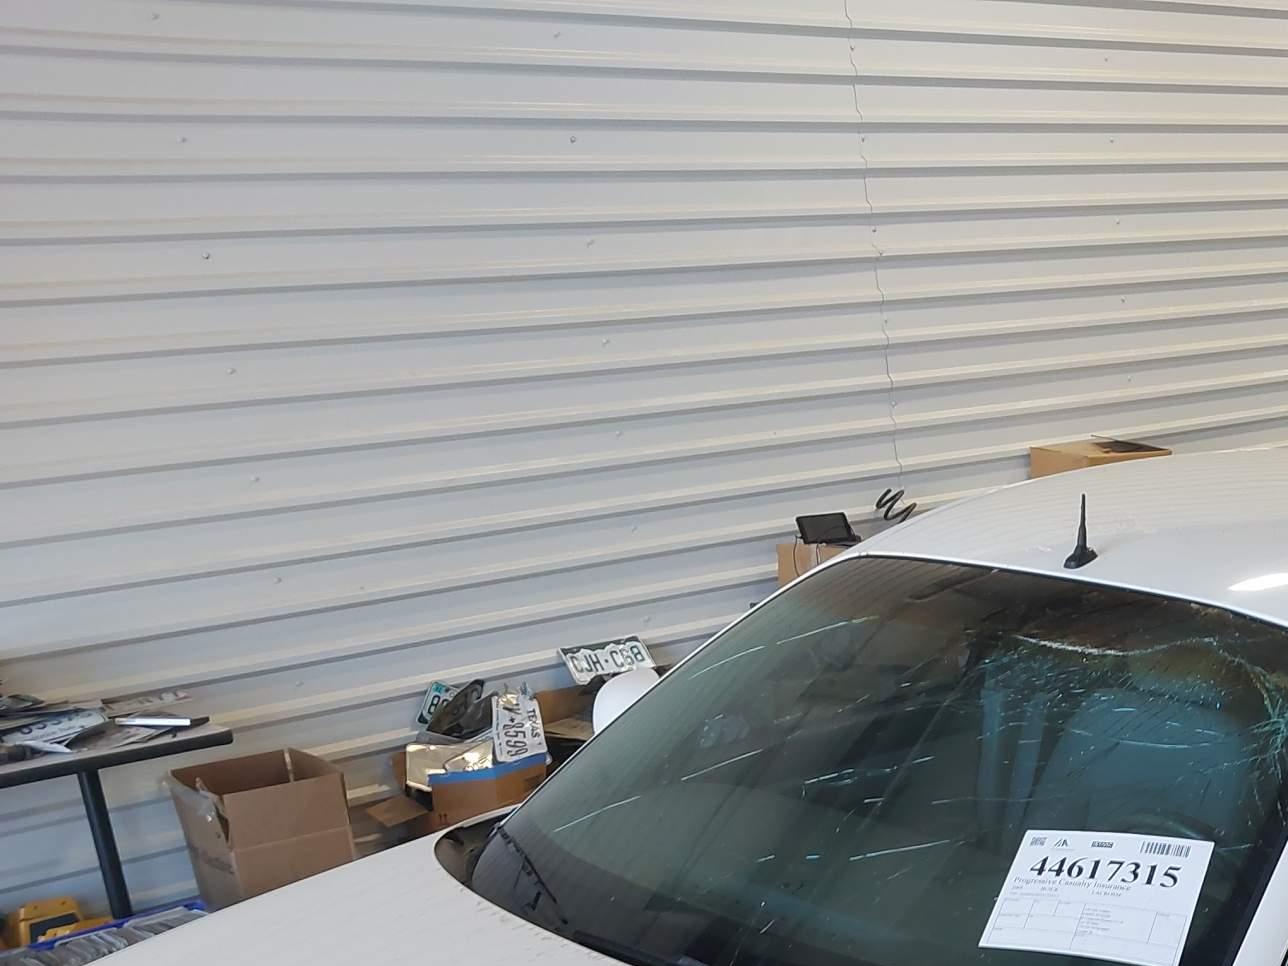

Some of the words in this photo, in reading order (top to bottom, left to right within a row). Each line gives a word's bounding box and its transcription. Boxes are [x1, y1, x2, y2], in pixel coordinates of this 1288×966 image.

[527, 708, 541, 738] TEXAS
[1013, 876, 1058, 886] Progressive
[1059, 879, 1092, 888] Casualty
[1093, 880, 1132, 891] Insurance
[1030, 856, 1182, 887] 44617315
